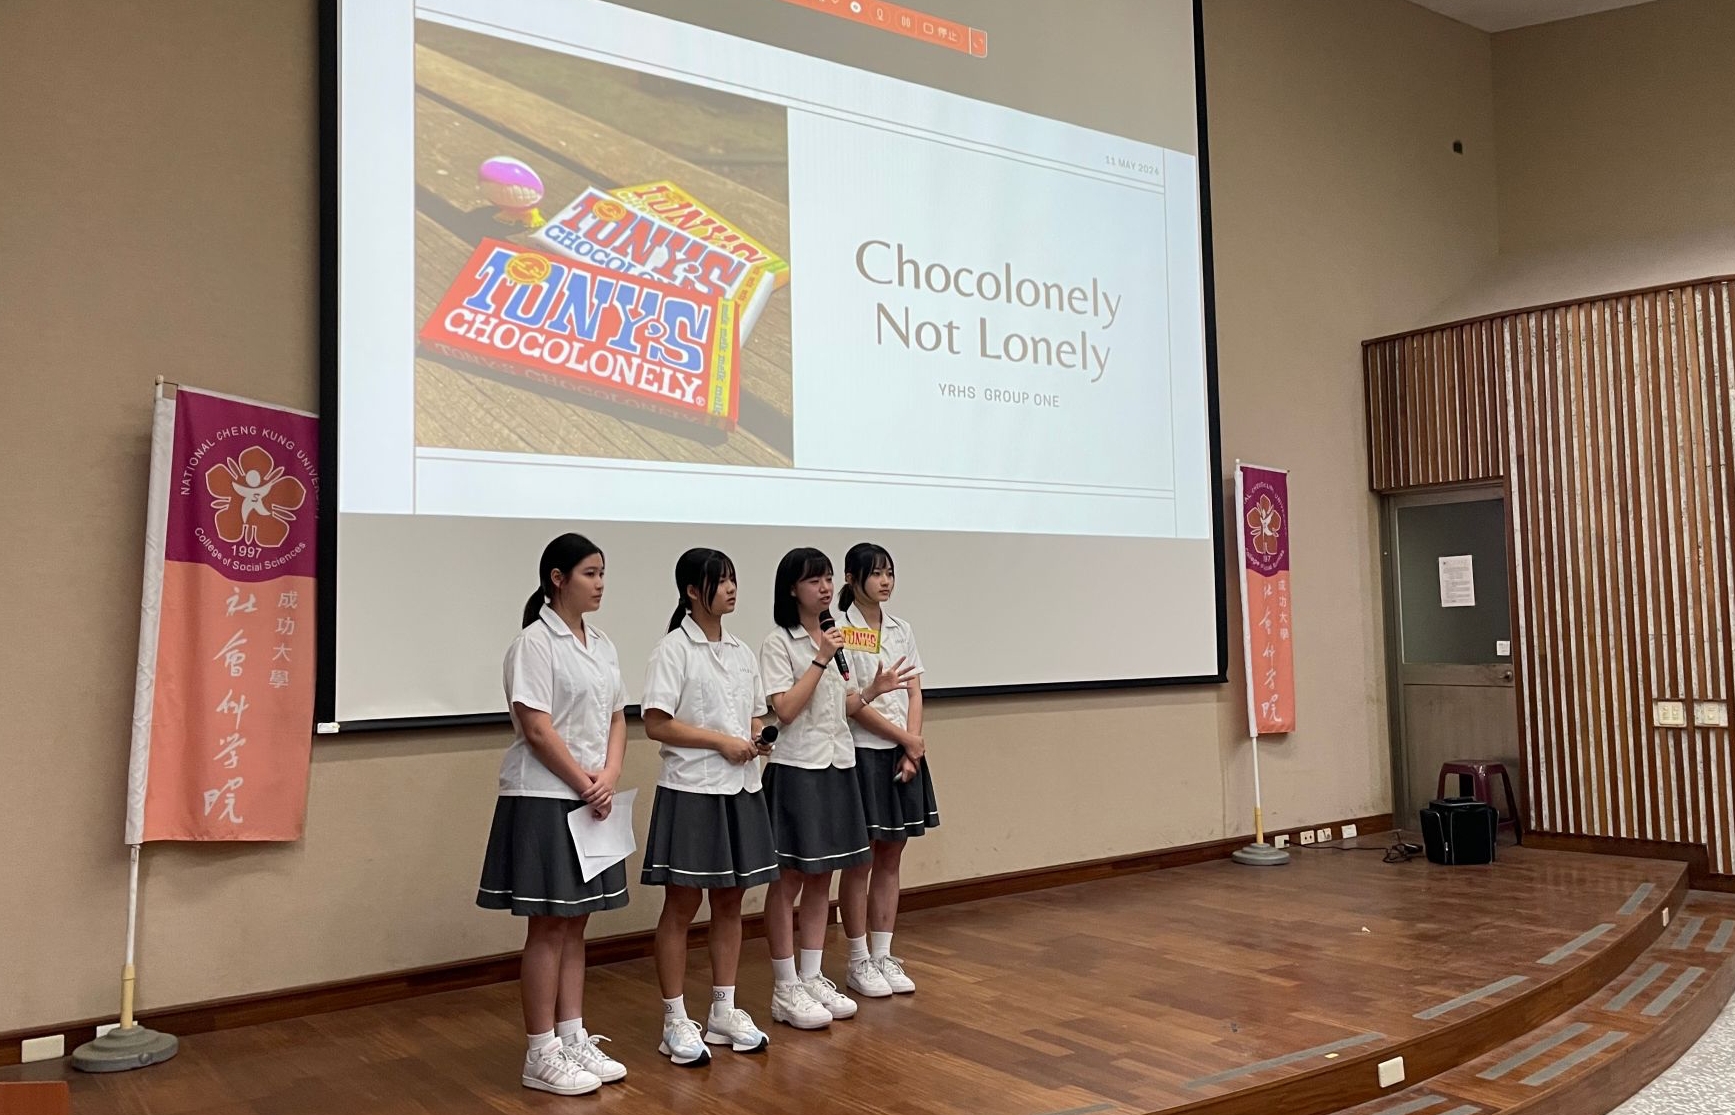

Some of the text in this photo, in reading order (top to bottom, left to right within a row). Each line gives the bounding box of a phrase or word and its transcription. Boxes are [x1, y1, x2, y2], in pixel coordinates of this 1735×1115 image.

[1105, 155, 1115, 165] 11
[1118, 158, 1136, 170] MAY
[464, 247, 712, 374] TONY'S
[855, 240, 1122, 330] Chocolonely
[443, 307, 702, 407] CHOCOLONELY
[876, 302, 1111, 384] Not Lonely
[938, 383, 1060, 408] YRHS GROUP ONE
[181, 439, 216, 495] NATIONAL
[216, 426, 257, 441] CHENG
[262, 428, 295, 450] KUNG
[194, 527, 306, 572] College of Social Sciences
[231, 545, 262, 559] 1997
[268, 591, 298, 689] 成功大學
